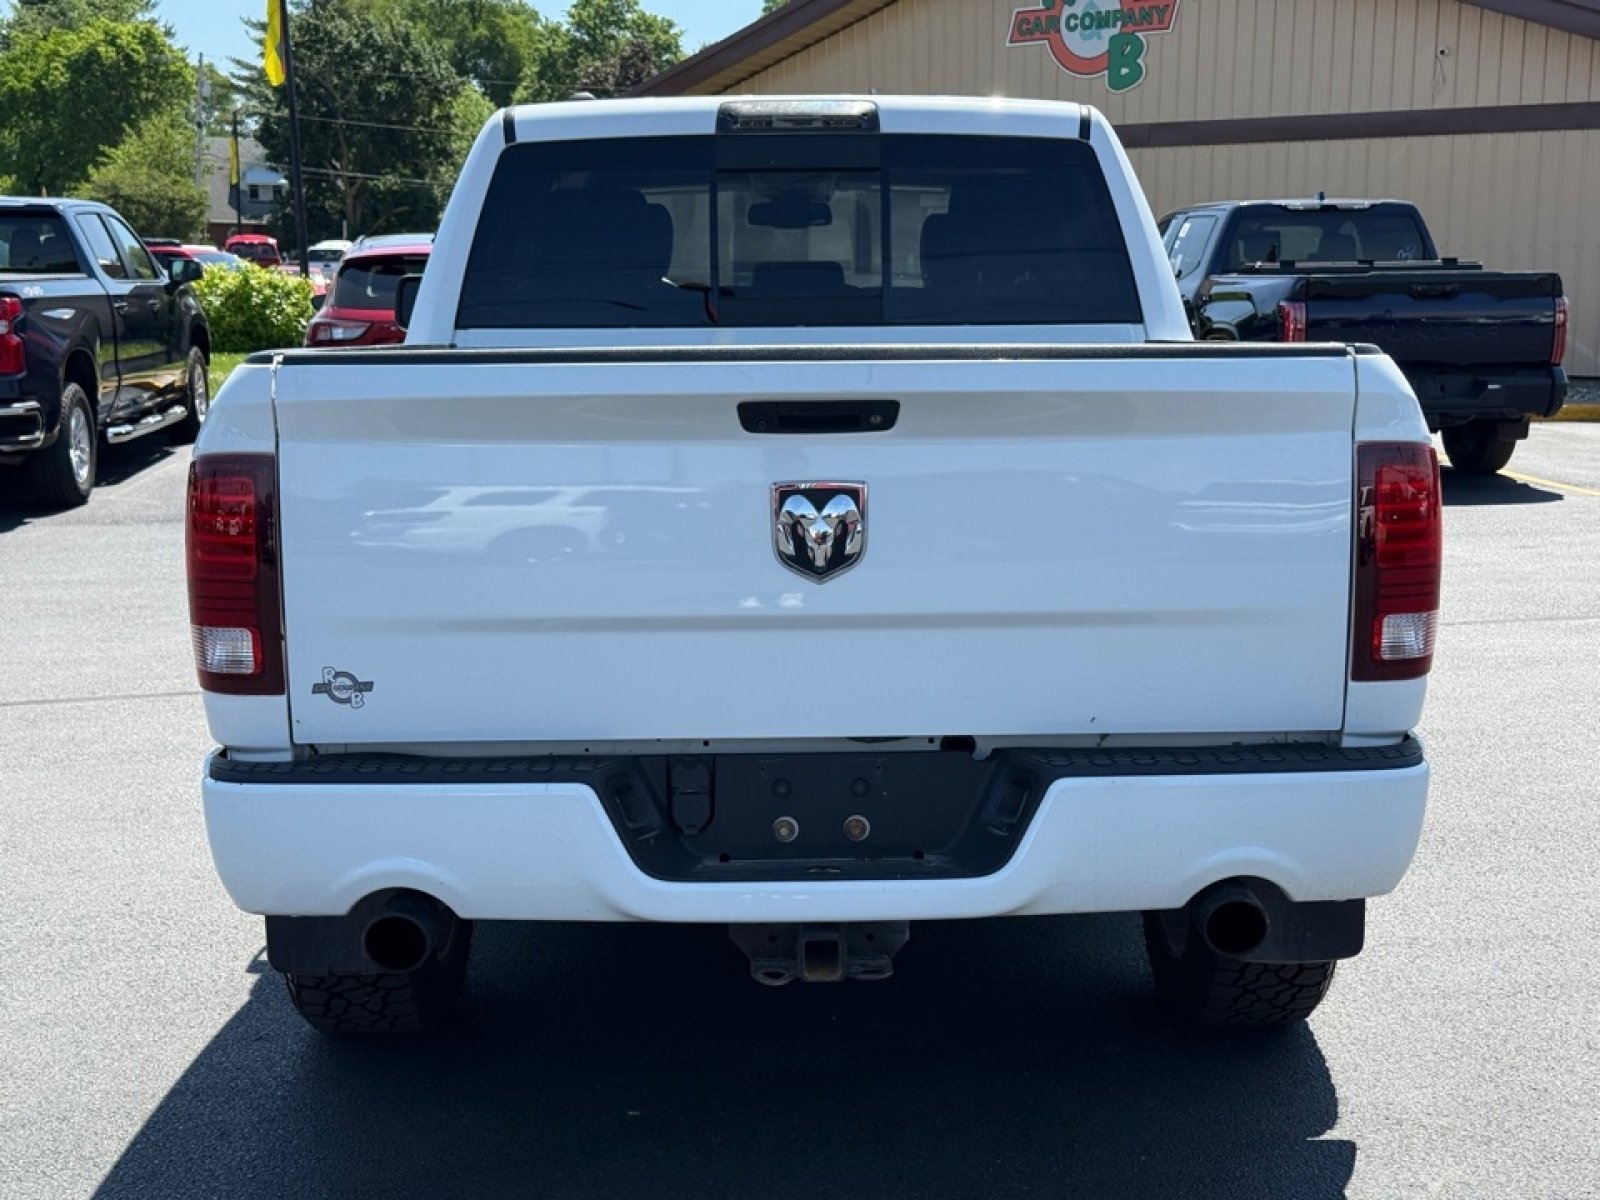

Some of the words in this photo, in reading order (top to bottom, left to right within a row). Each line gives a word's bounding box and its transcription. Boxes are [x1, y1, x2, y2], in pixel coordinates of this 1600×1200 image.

[1016, 15, 1060, 36] CAR
[1065, 5, 1169, 32] COMPANY
[1108, 33, 1144, 91] B
